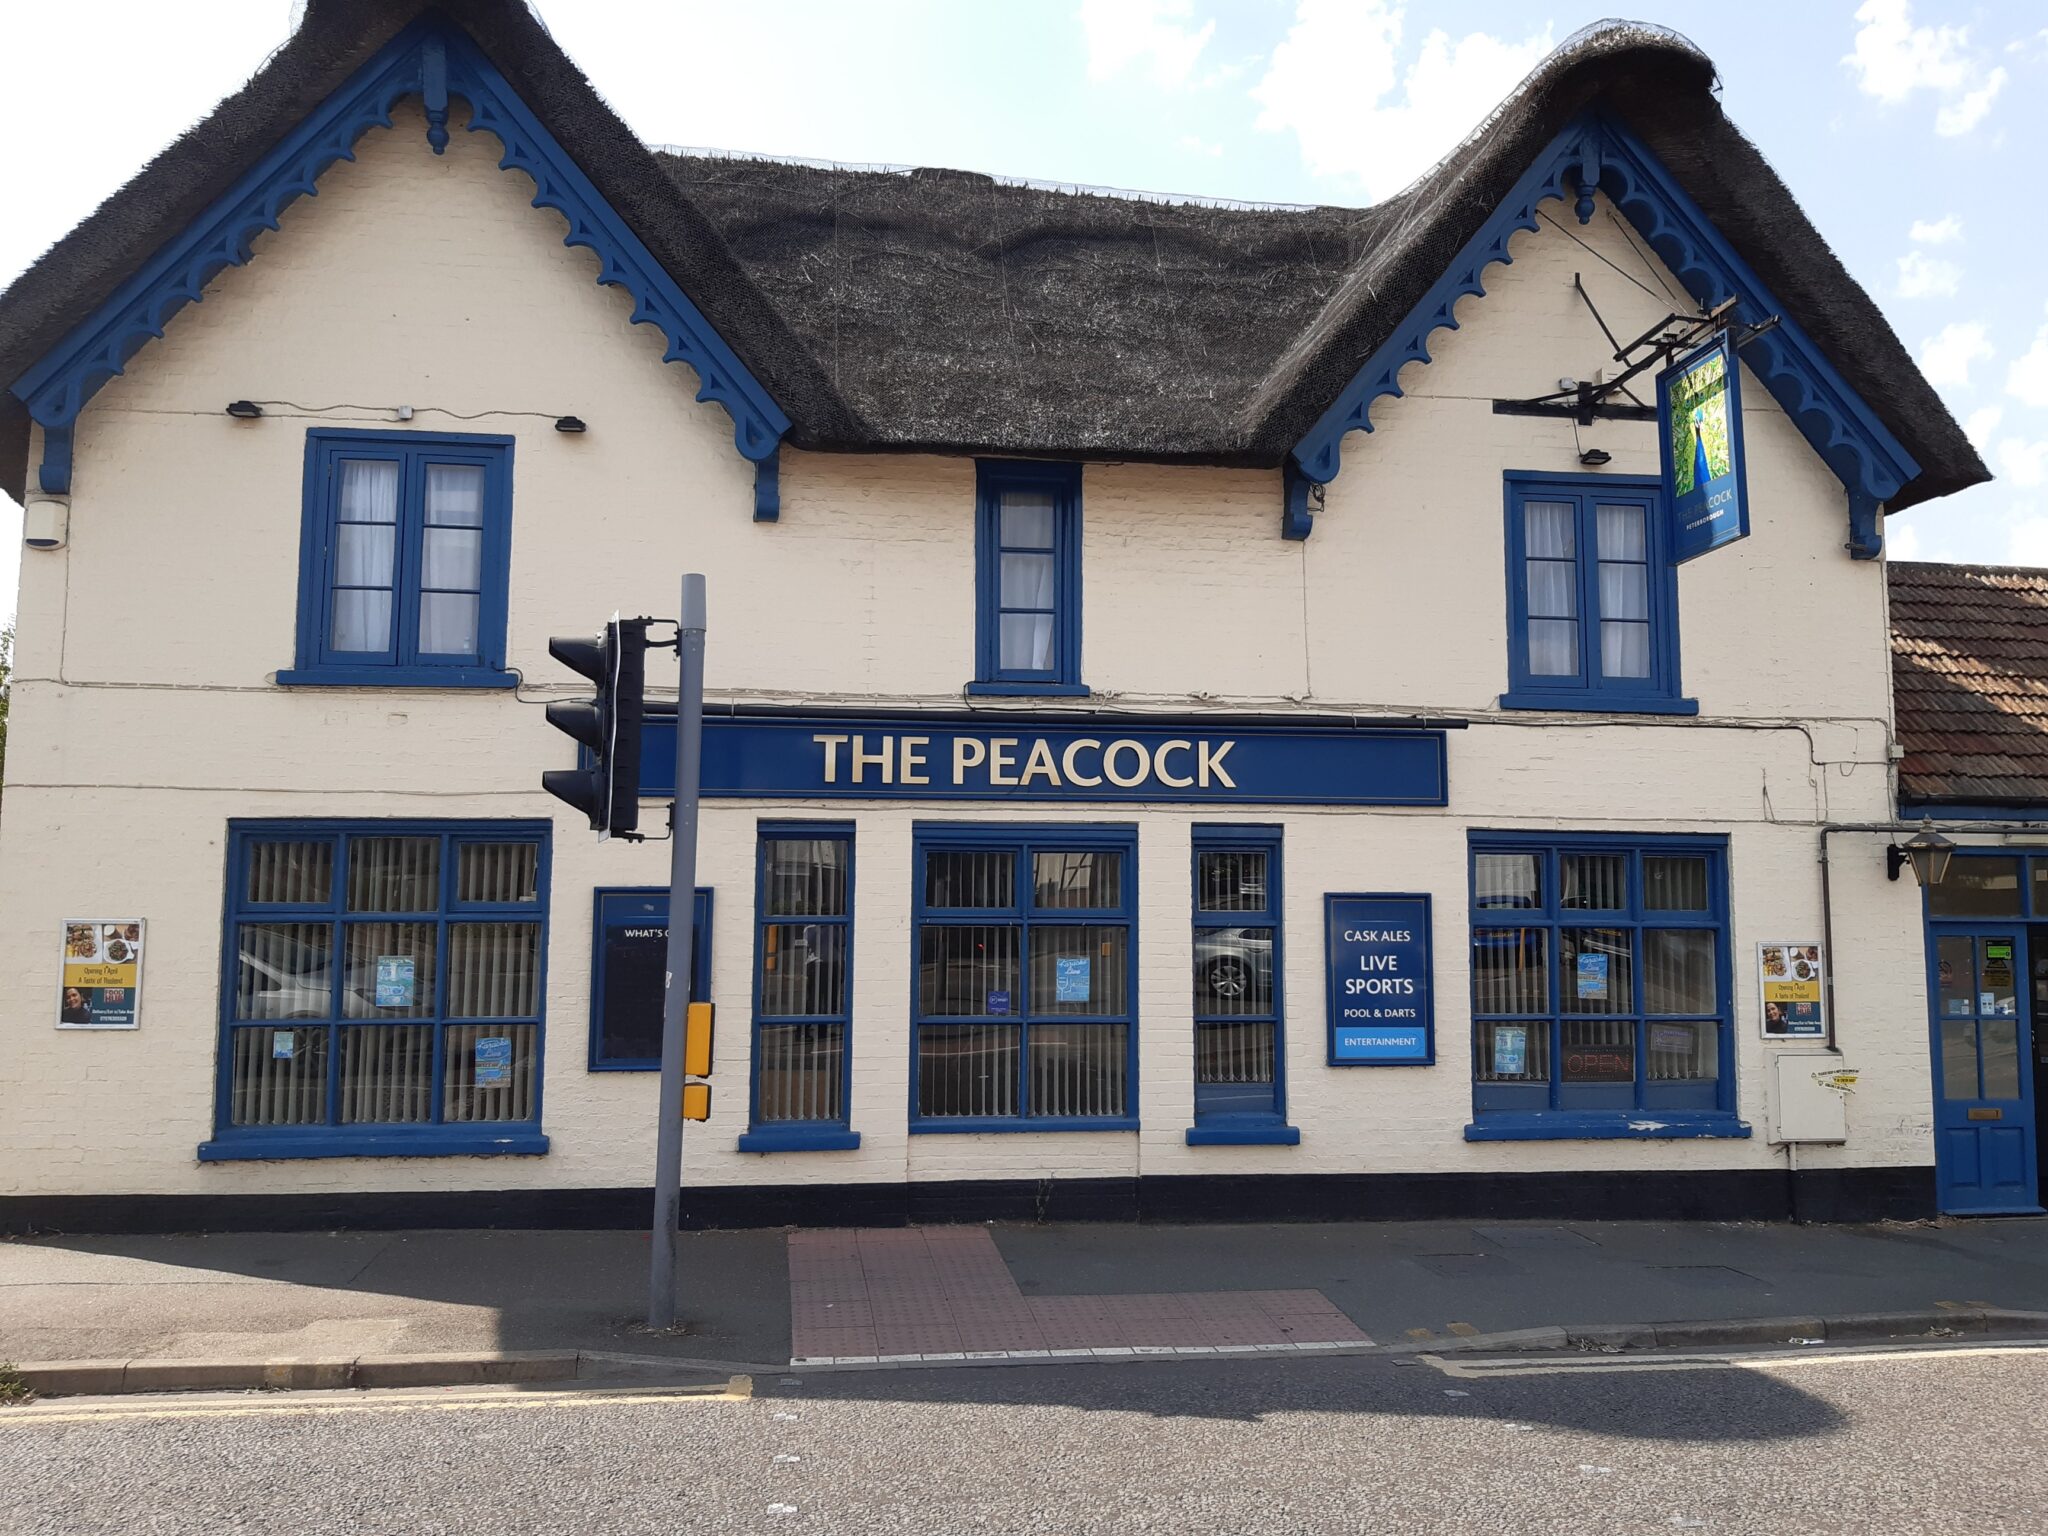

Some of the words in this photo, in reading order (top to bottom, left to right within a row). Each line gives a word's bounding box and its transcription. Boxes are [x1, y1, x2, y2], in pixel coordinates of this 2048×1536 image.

[813, 734, 930, 784] THE
[953, 737, 1237, 788] PEACOCK
[624, 928, 663, 938] WHAT'S
[1344, 930, 1378, 942] CASK
[1381, 930, 1411, 942] ALES
[1360, 955, 1398, 971] LIVE
[1345, 978, 1414, 995] SPORTS
[1344, 1008, 1371, 1018] POOL
[1373, 1009, 1382, 1018] &
[1385, 1009, 1416, 1018] DARTS
[1344, 1037, 1416, 1046] ENTERTAINMENT
[1567, 1054, 1630, 1073] OPEN
